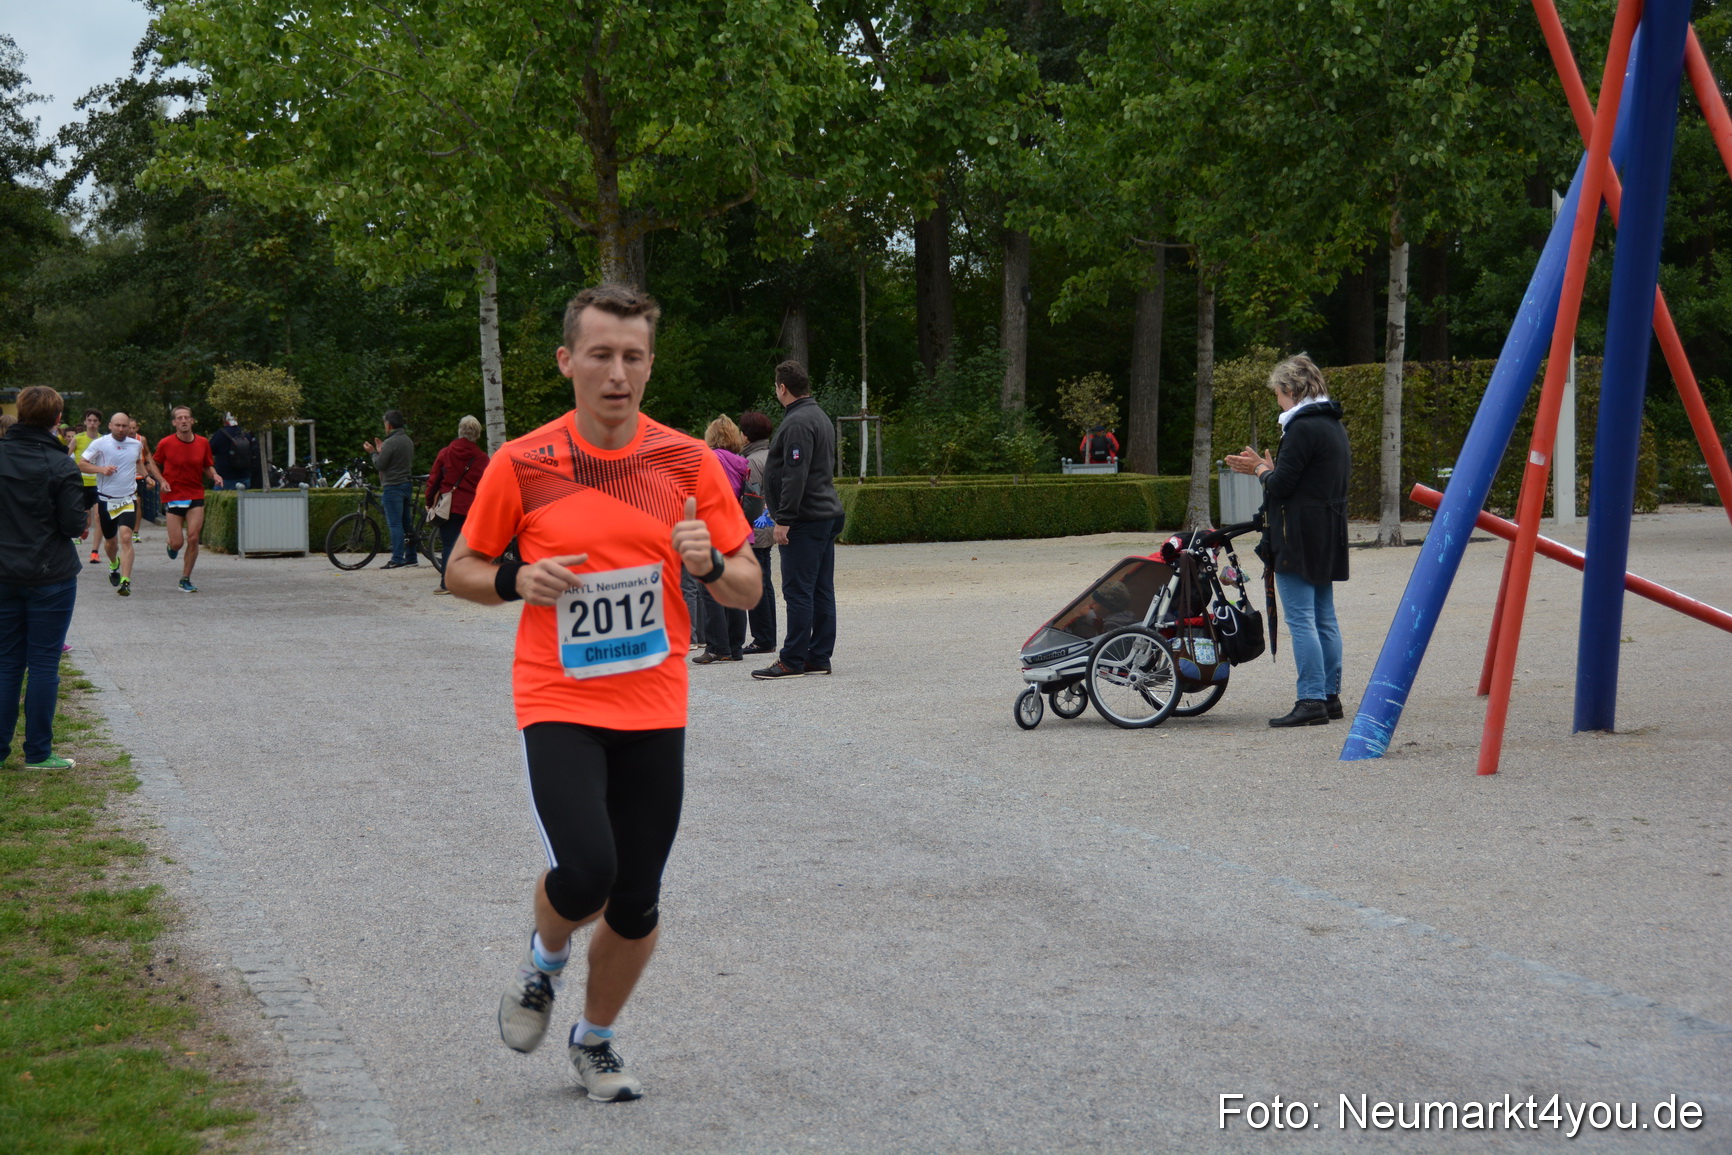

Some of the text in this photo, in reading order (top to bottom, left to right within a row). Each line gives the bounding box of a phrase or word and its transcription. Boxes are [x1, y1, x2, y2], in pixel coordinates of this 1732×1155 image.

[523, 451, 559, 467] adidas
[596, 577, 648, 592] Neumarkt
[569, 590, 655, 637] 2012
[585, 641, 647, 663] Christian
